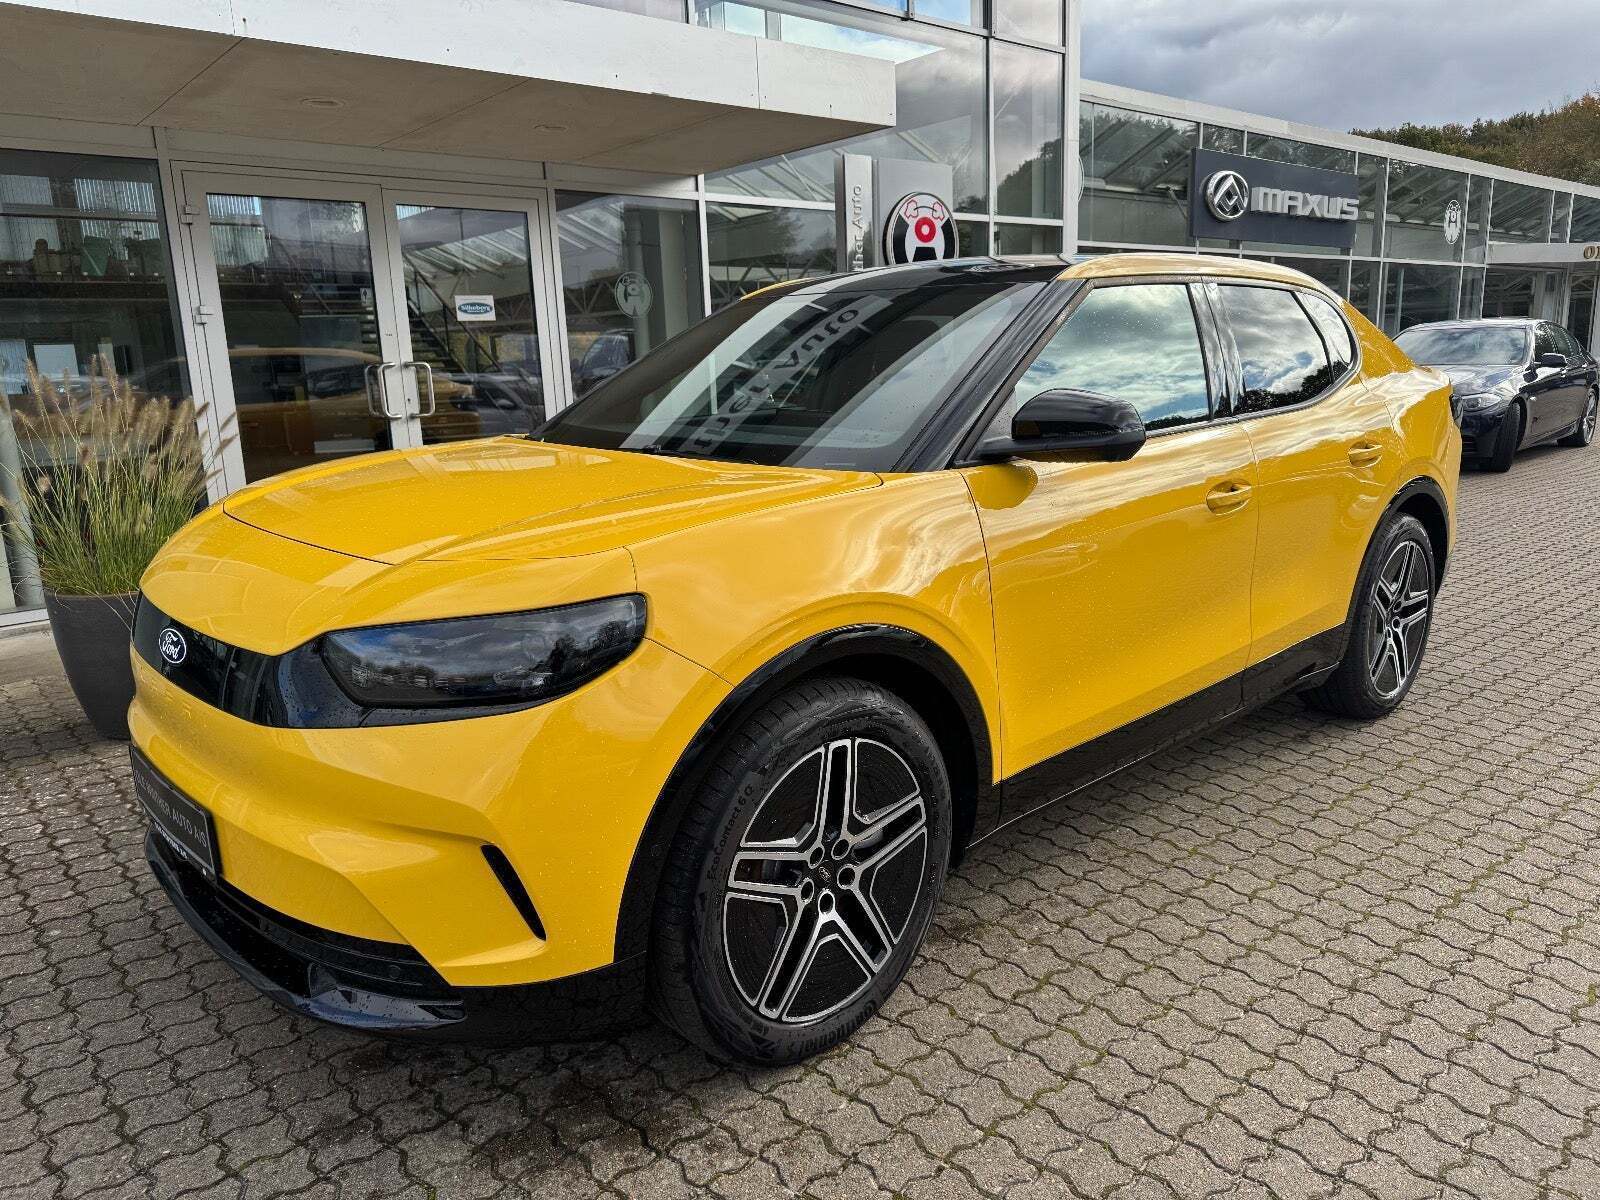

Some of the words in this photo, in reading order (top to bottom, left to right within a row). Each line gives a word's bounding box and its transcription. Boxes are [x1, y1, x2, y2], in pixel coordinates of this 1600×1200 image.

[852, 183, 863, 229] Auto
[1251, 187, 1360, 221] MAXUS
[162, 631, 181, 660] Ford
[171, 807, 193, 835] AUTO
[194, 824, 207, 848] A/S
